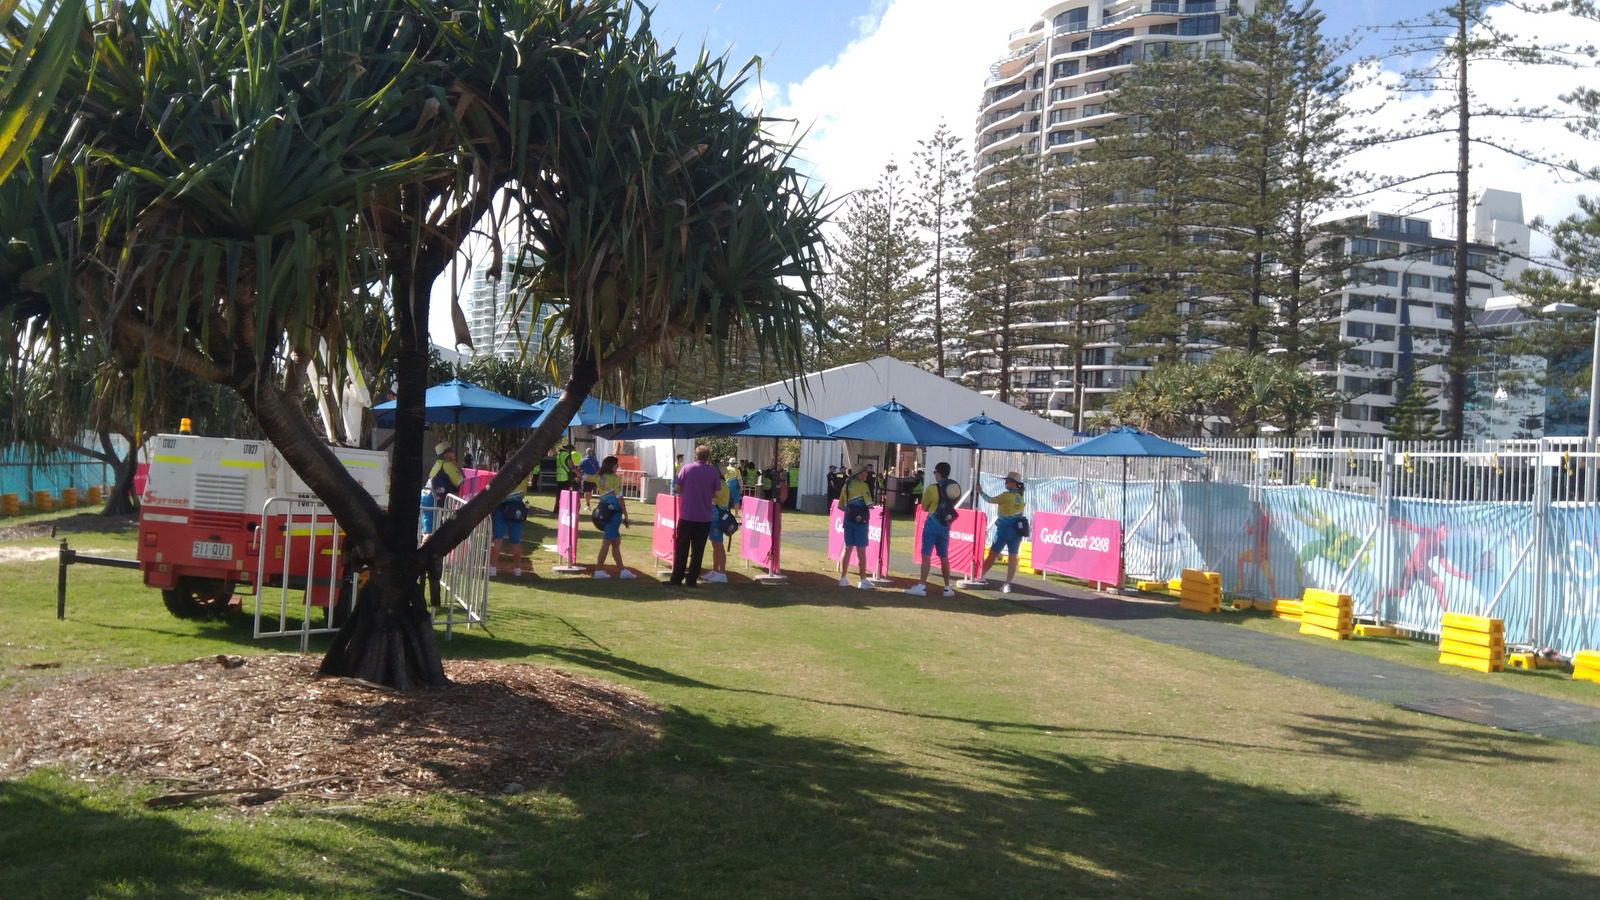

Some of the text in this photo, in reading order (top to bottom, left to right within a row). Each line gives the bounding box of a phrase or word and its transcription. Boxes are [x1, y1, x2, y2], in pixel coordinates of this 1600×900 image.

[1040, 527, 1110, 553] Gold Coast 2018
